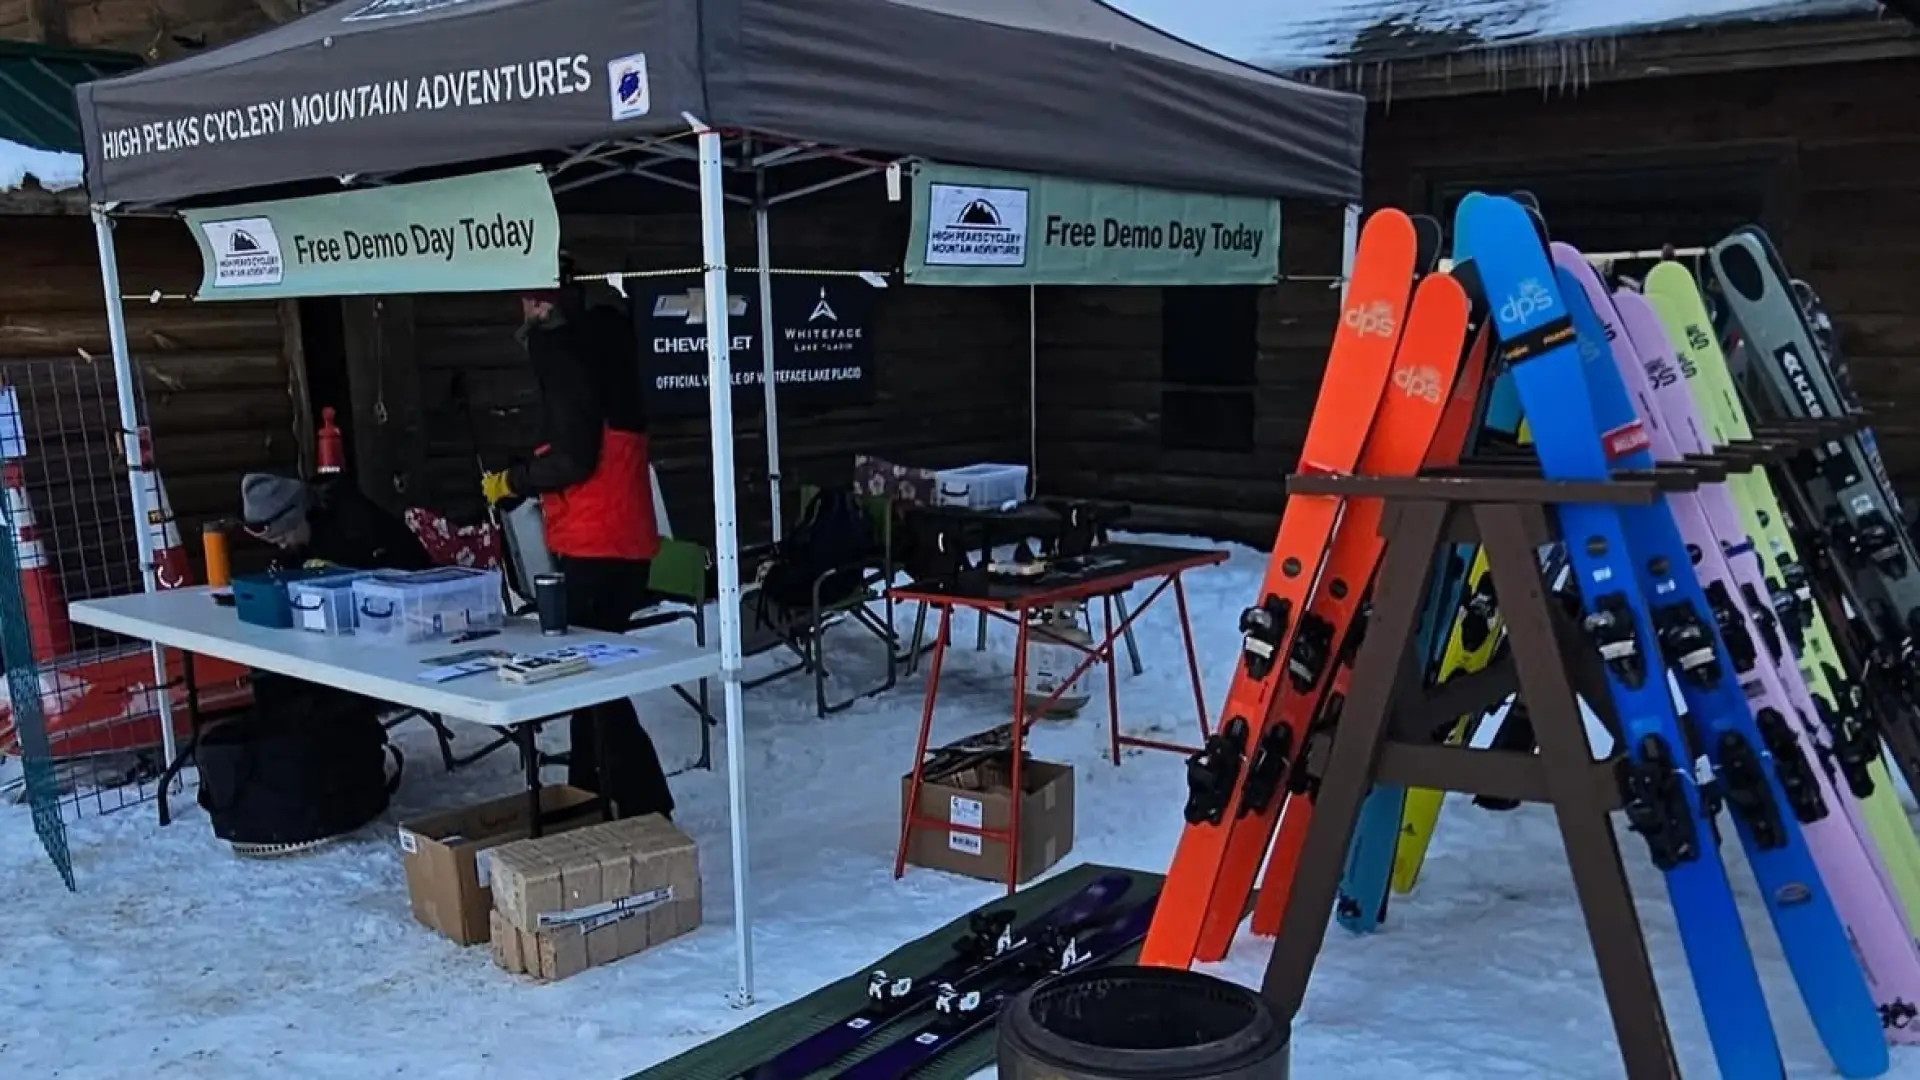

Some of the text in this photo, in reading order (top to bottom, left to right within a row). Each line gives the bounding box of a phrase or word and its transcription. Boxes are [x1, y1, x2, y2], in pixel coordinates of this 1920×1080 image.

[102, 54, 591, 160] HIGH PEAKS CYCLERY MOUNTAIN ADVENTURES
[293, 213, 534, 264] Free Demo Day Today
[1045, 215, 1263, 257] Free Demo Day Today
[1345, 303, 1396, 338] dps
[1500, 288, 1553, 325] dps
[654, 335, 753, 353] CHEVRET
[785, 328, 862, 339] WHITEFACE
[655, 374, 701, 390] OFFICIAL
[743, 372, 755, 385] OF
[756, 367, 807, 384] WTEFACE
[809, 368, 830, 382] LAKE
[1393, 366, 1442, 404] dps
